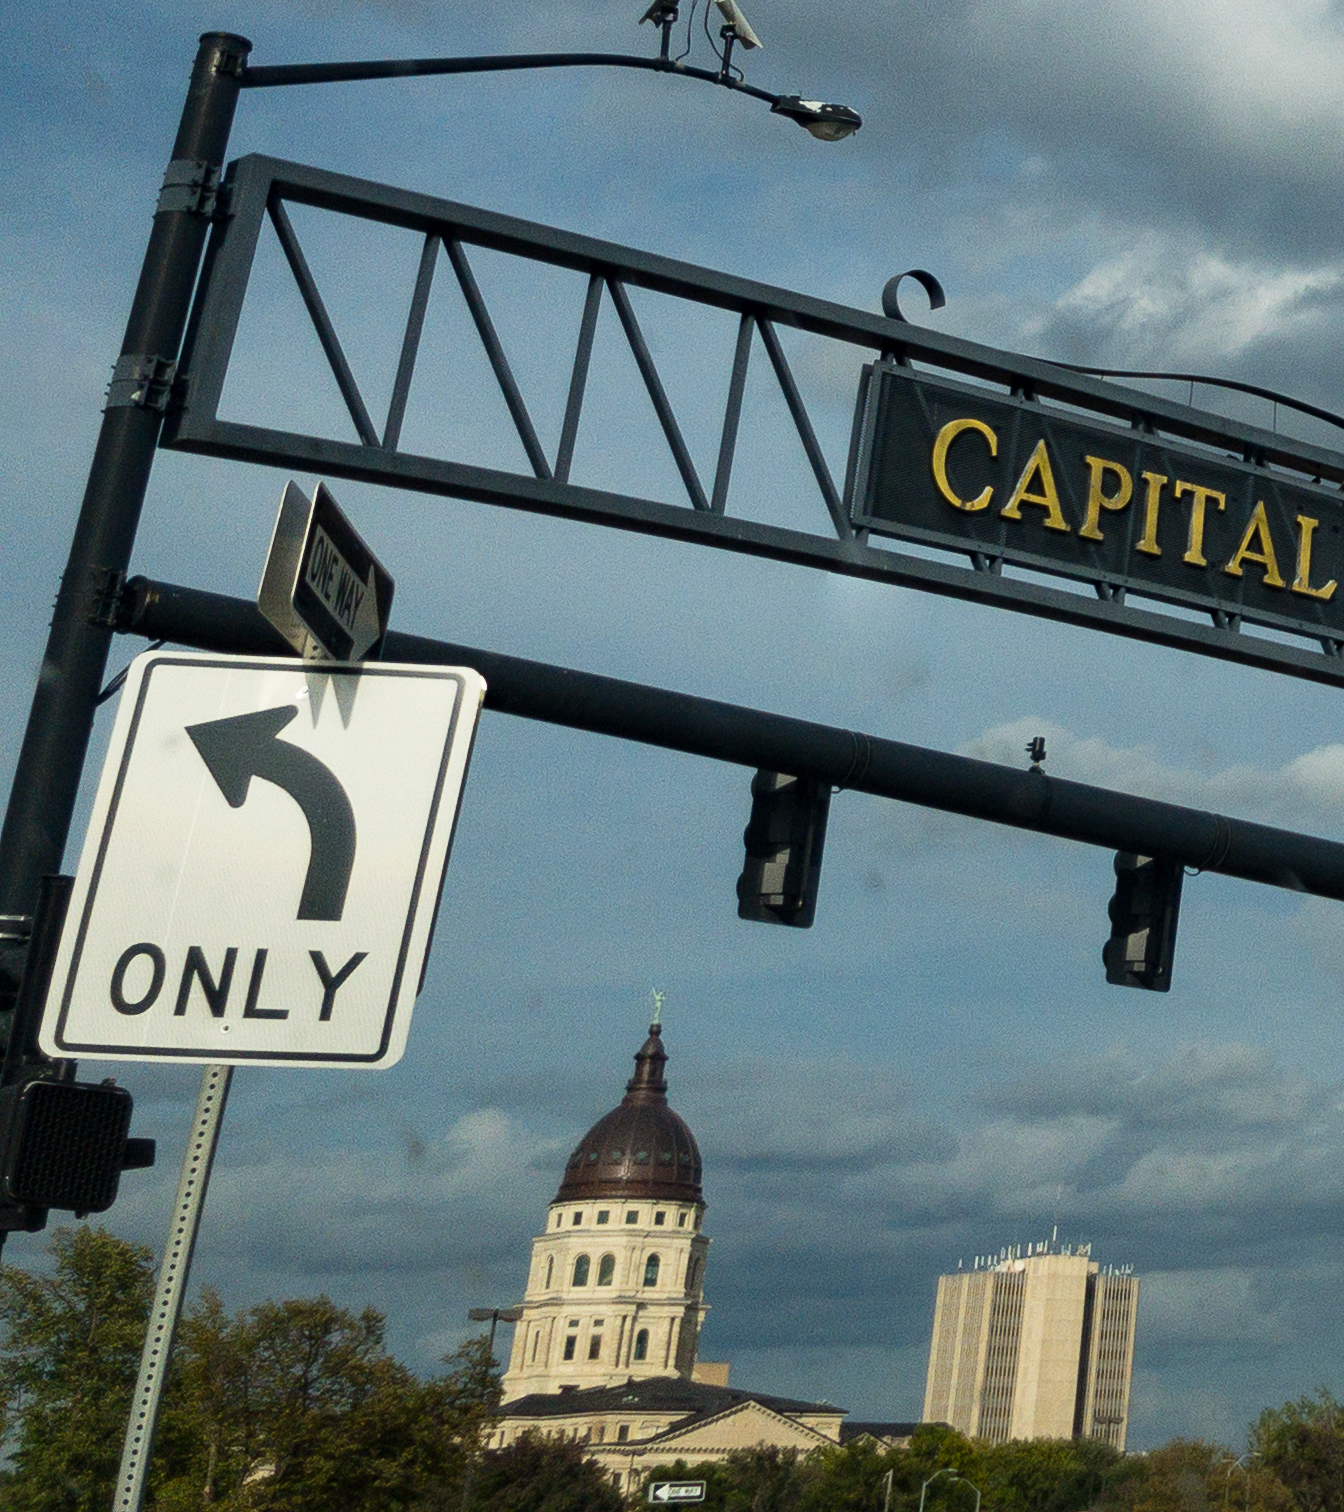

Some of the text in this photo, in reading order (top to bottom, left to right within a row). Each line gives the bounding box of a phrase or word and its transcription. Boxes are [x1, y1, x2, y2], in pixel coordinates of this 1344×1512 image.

[931, 418, 1338, 600] CAPITAL
[311, 535, 364, 630] ONE WAY
[110, 942, 370, 1021] ONLY
